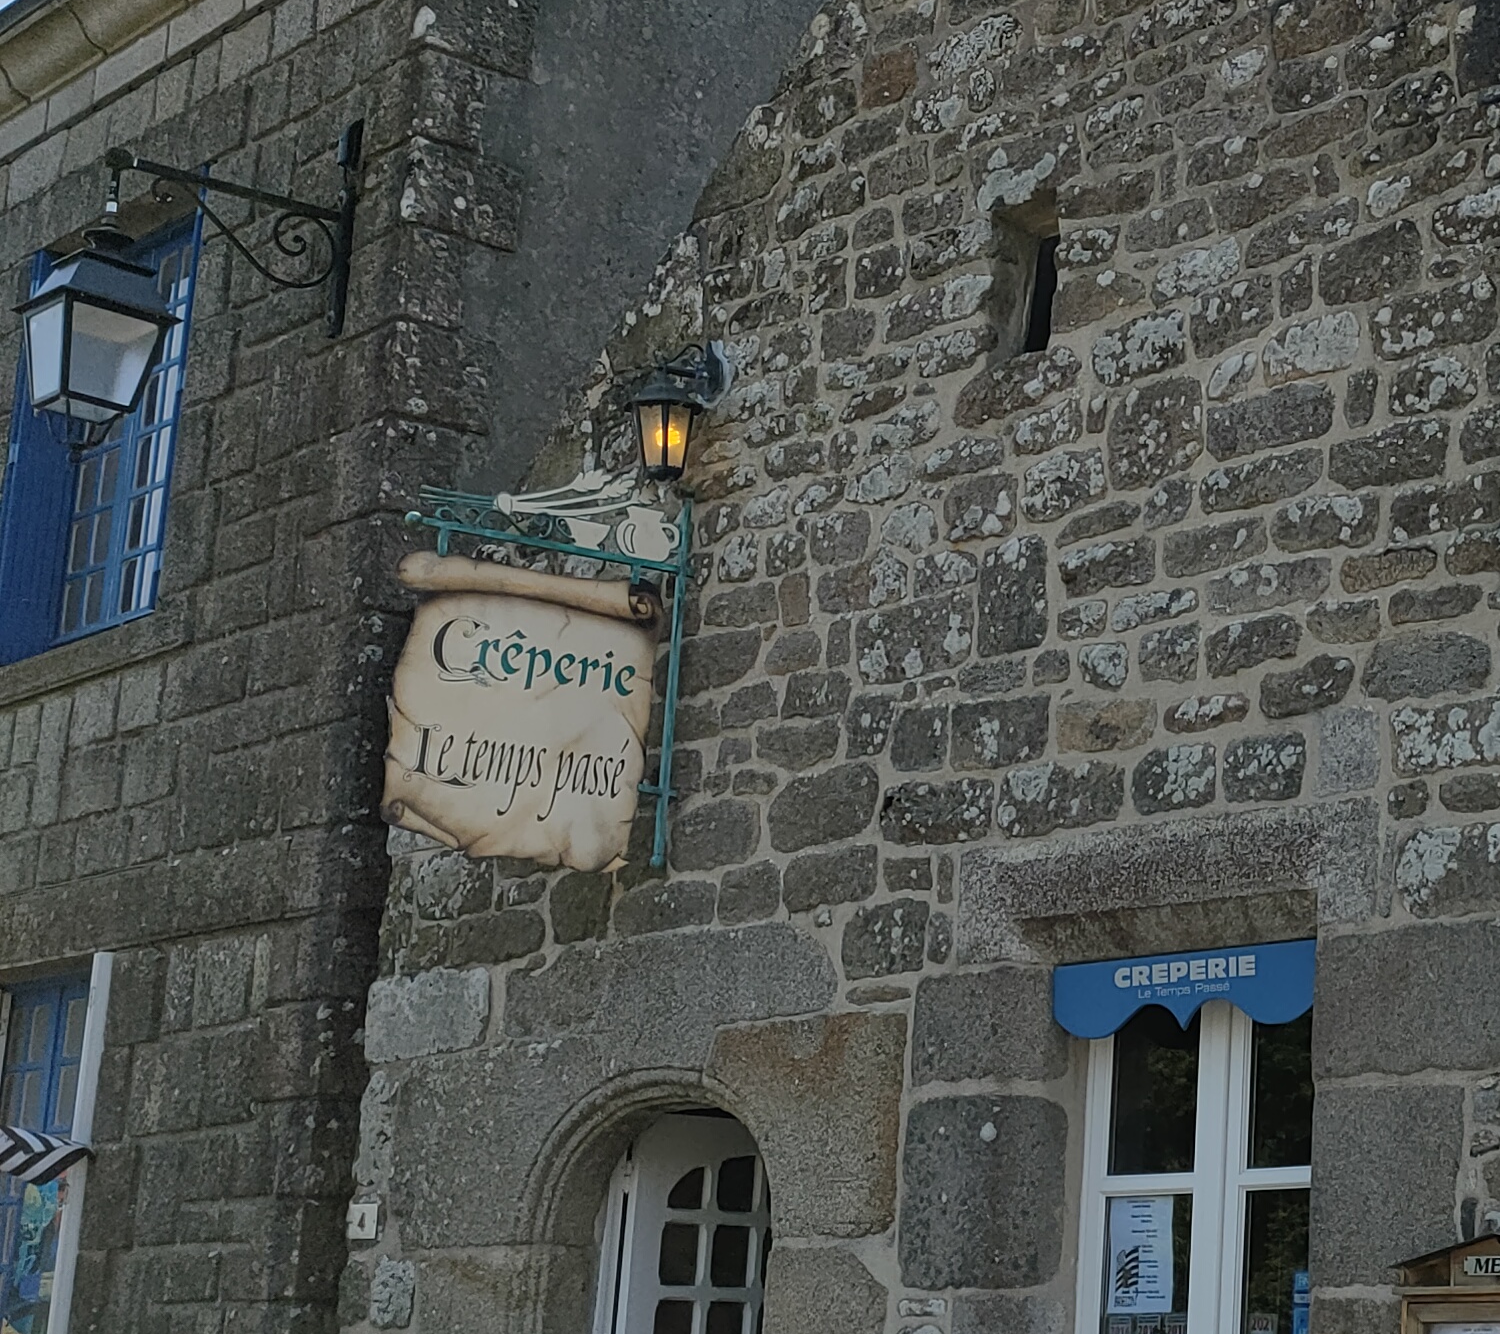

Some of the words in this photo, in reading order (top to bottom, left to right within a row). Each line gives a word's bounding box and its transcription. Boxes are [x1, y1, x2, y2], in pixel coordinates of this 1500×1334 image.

[432, 616, 636, 696] Crêperie
[403, 724, 476, 789] Le
[461, 731, 548, 816] temps
[537, 738, 630, 822] passé
[1113, 954, 1257, 989] CREPERIE
[1137, 988, 1152, 999] Le
[1154, 985, 1191, 997] Temps
[1194, 980, 1231, 994] Passé
[357, 1211, 366, 1232] 4
